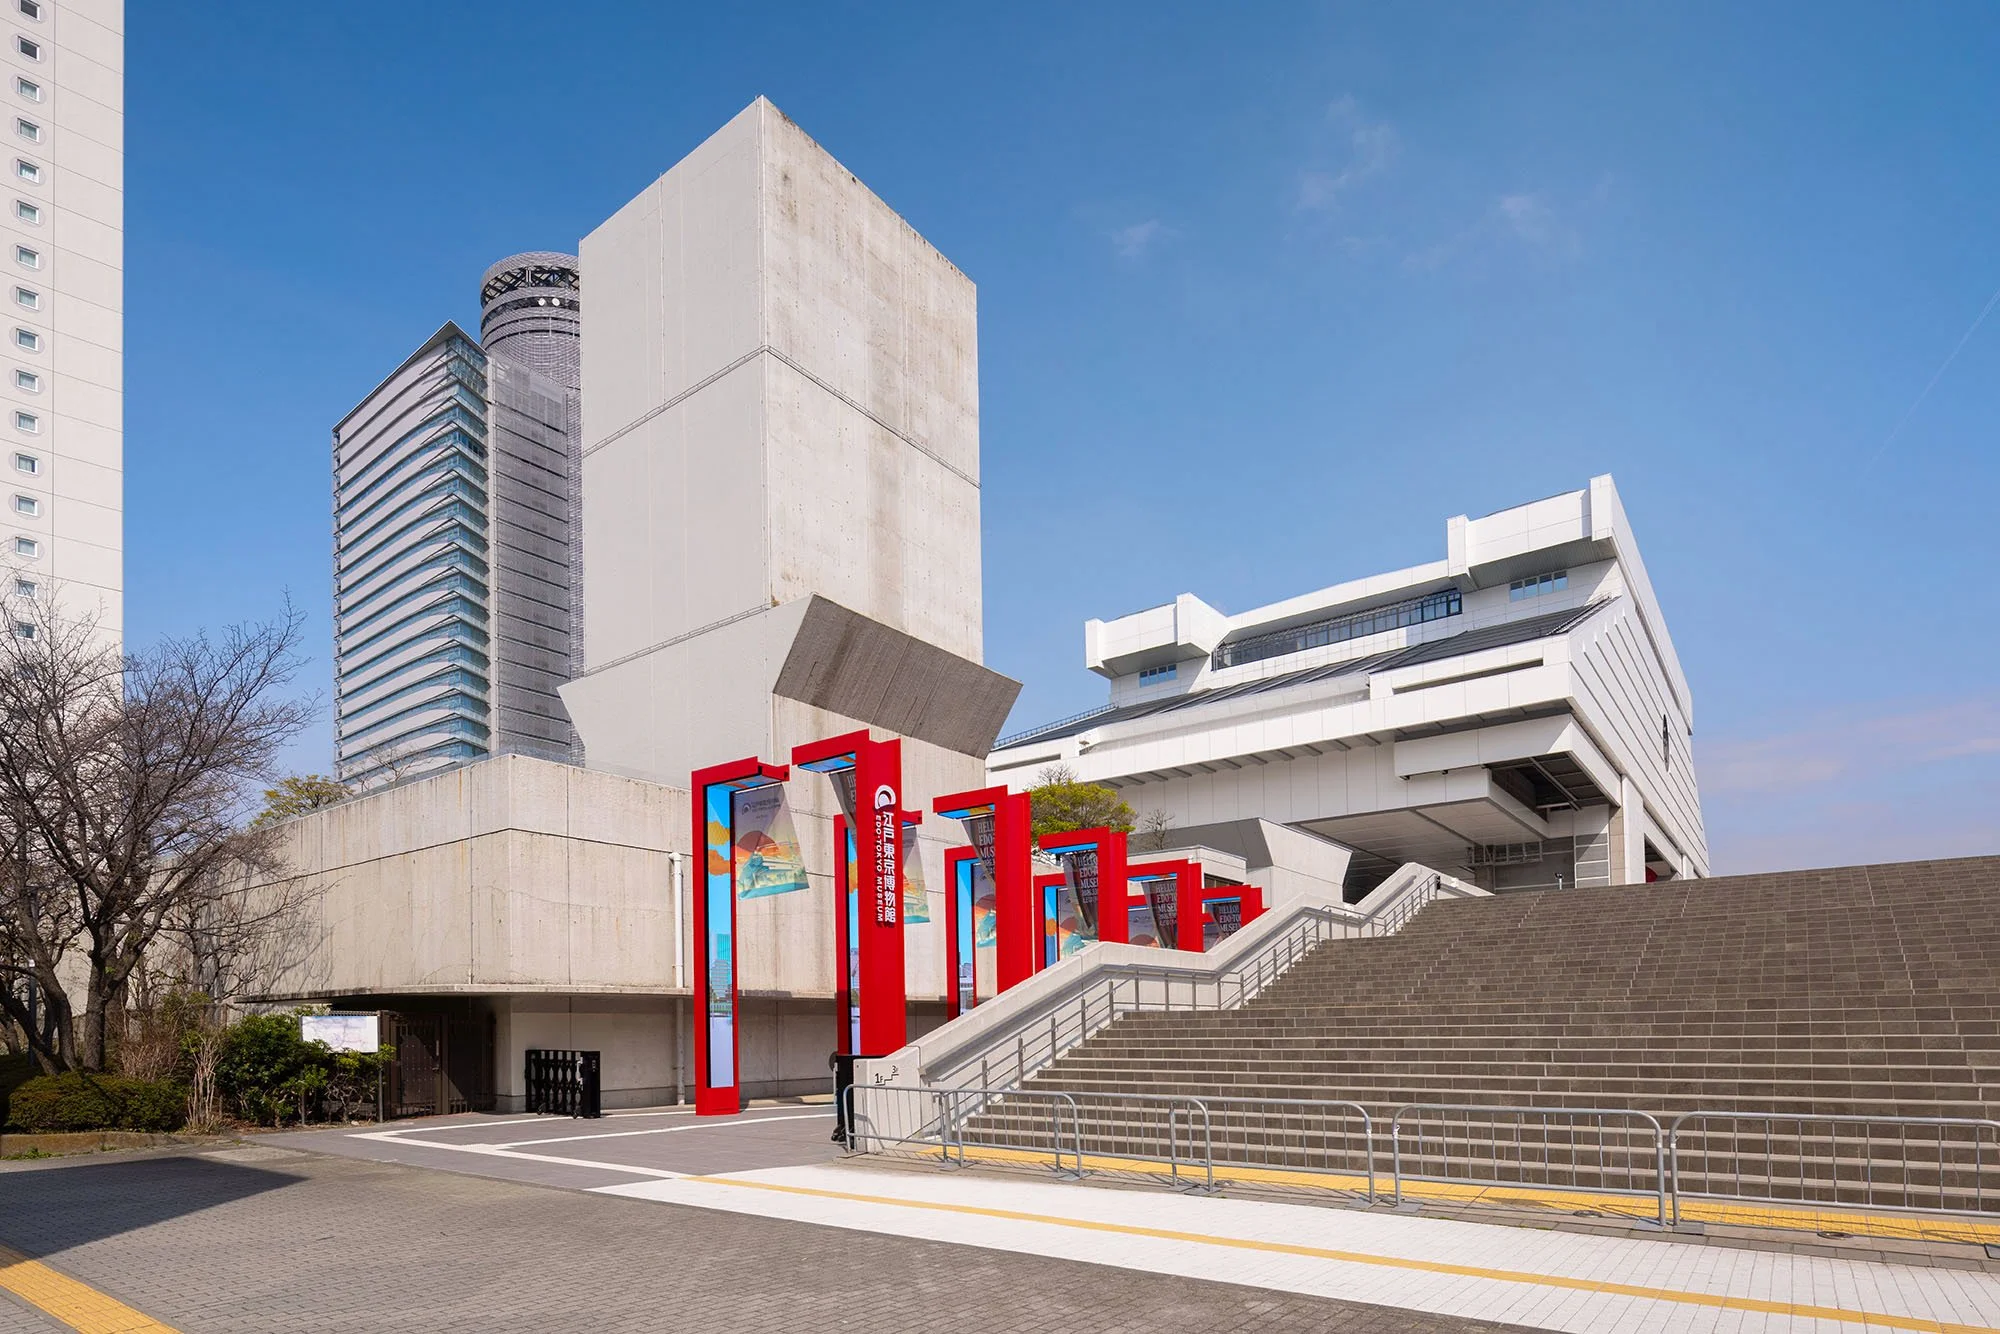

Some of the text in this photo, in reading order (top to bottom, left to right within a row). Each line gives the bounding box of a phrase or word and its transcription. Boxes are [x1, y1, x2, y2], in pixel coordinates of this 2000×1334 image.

[883, 812, 896, 922] 江戸東京博物館
[1080, 877, 1098, 888] MUSE
[875, 1073, 883, 1083] 1F
